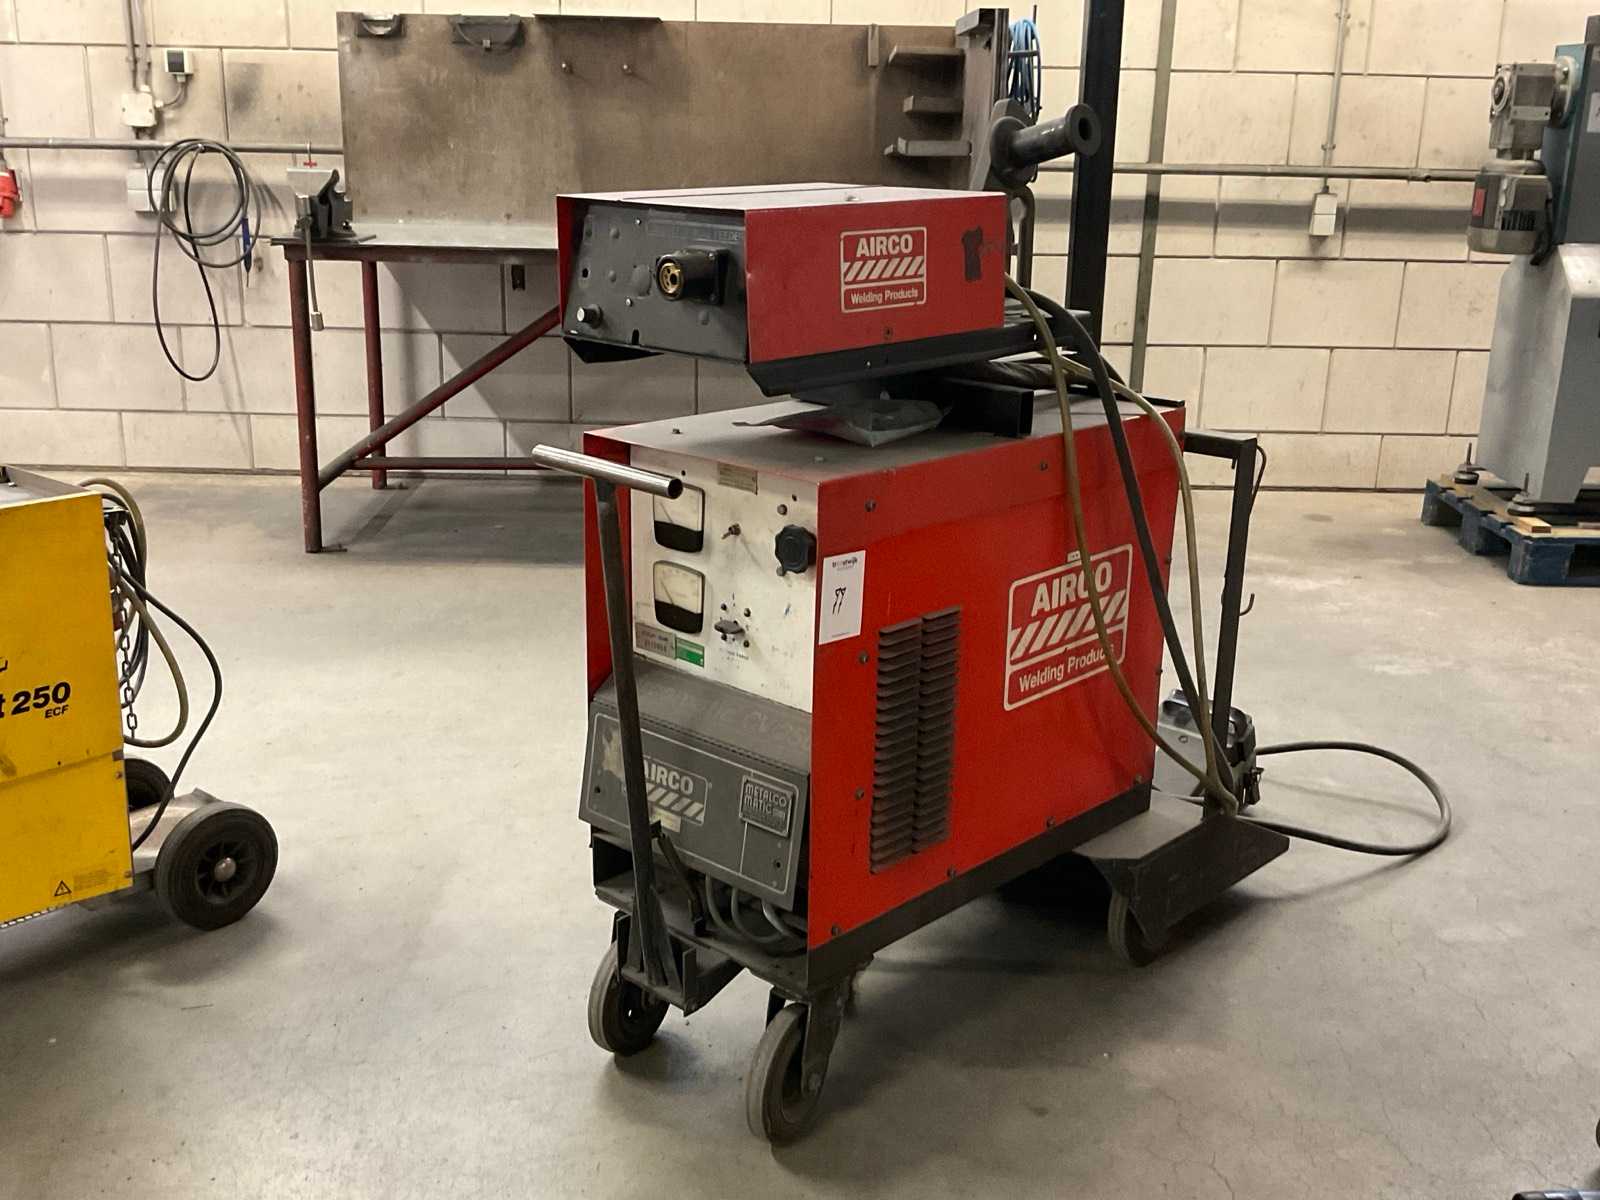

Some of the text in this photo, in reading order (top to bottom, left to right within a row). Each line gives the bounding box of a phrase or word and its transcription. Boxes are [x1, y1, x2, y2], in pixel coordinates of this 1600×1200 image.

[856, 234, 914, 257] AIRCO
[850, 287, 919, 305] Welding Products
[1031, 561, 1113, 617] AIRCO
[1018, 662, 1065, 693] Welding
[11, 681, 71, 716] 250
[45, 704, 69, 718] ECF
[744, 796, 773, 815] MATIC
[745, 784, 788, 809] METALCO
